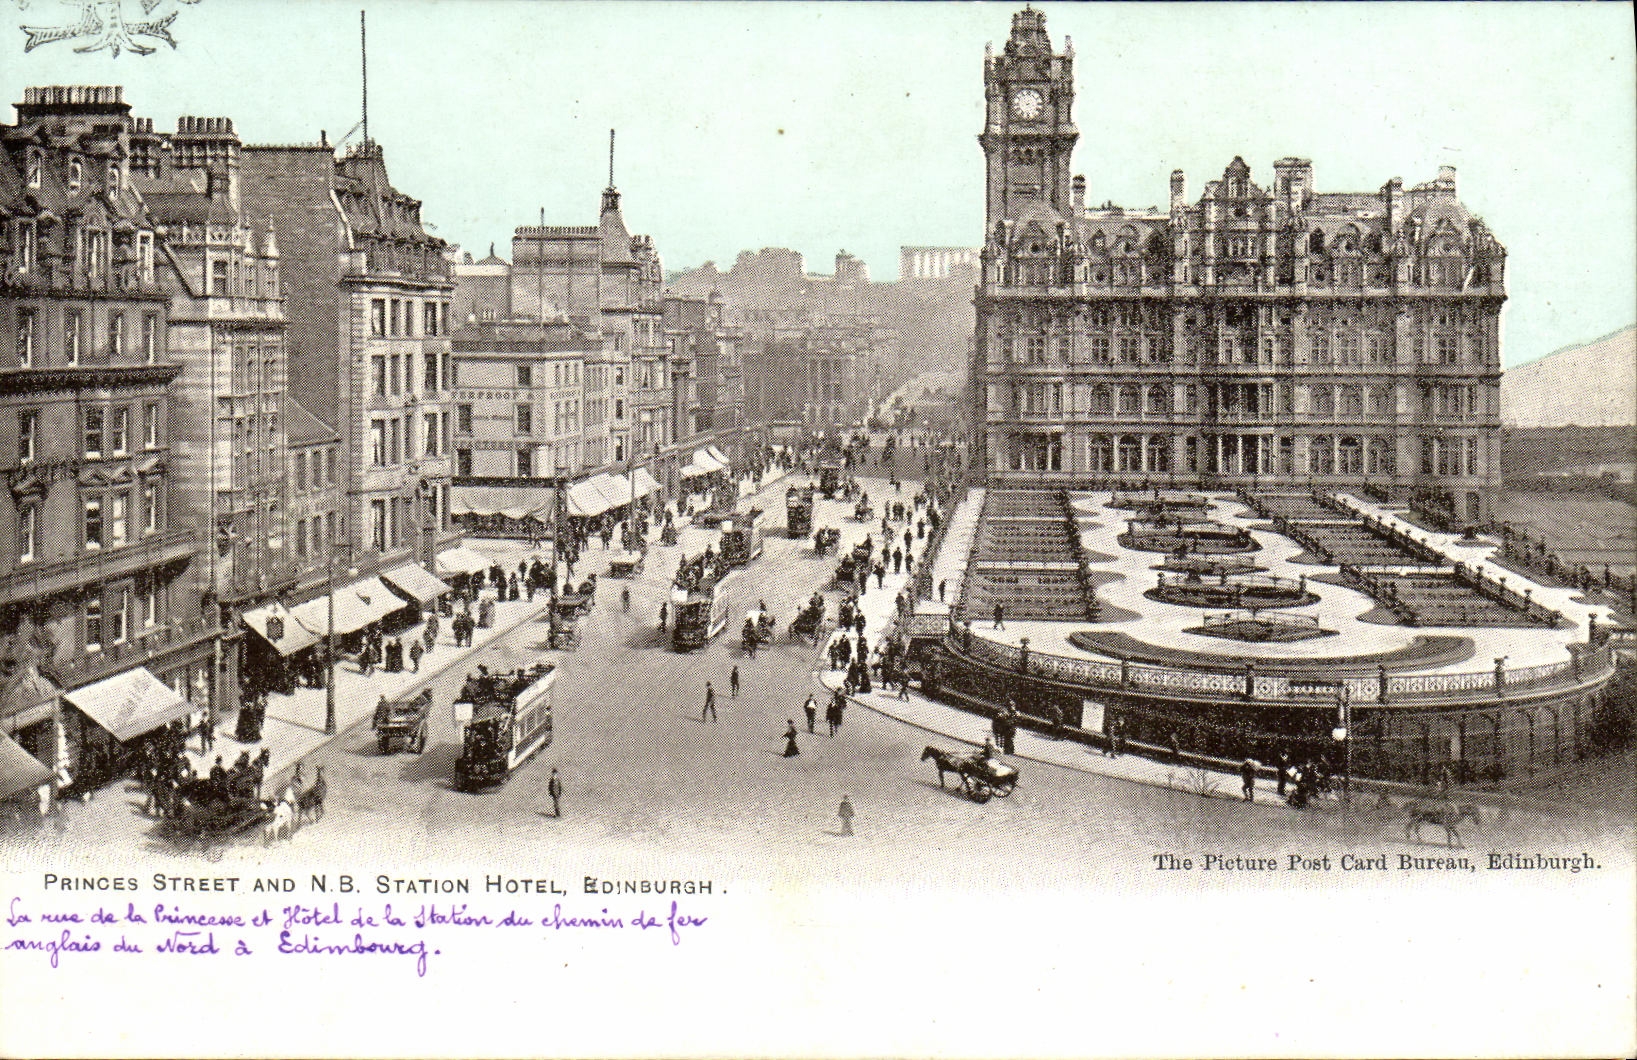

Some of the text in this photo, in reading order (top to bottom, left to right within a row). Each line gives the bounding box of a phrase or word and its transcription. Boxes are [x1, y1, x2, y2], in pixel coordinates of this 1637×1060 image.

[7, 897, 708, 945] La rue de la Princesse et Hôtel de la Station du chemin de fer
[5, 930, 102, 969] anglais
[113, 935, 143, 954] du
[156, 930, 220, 956] Nord
[234, 939, 253, 956] à
